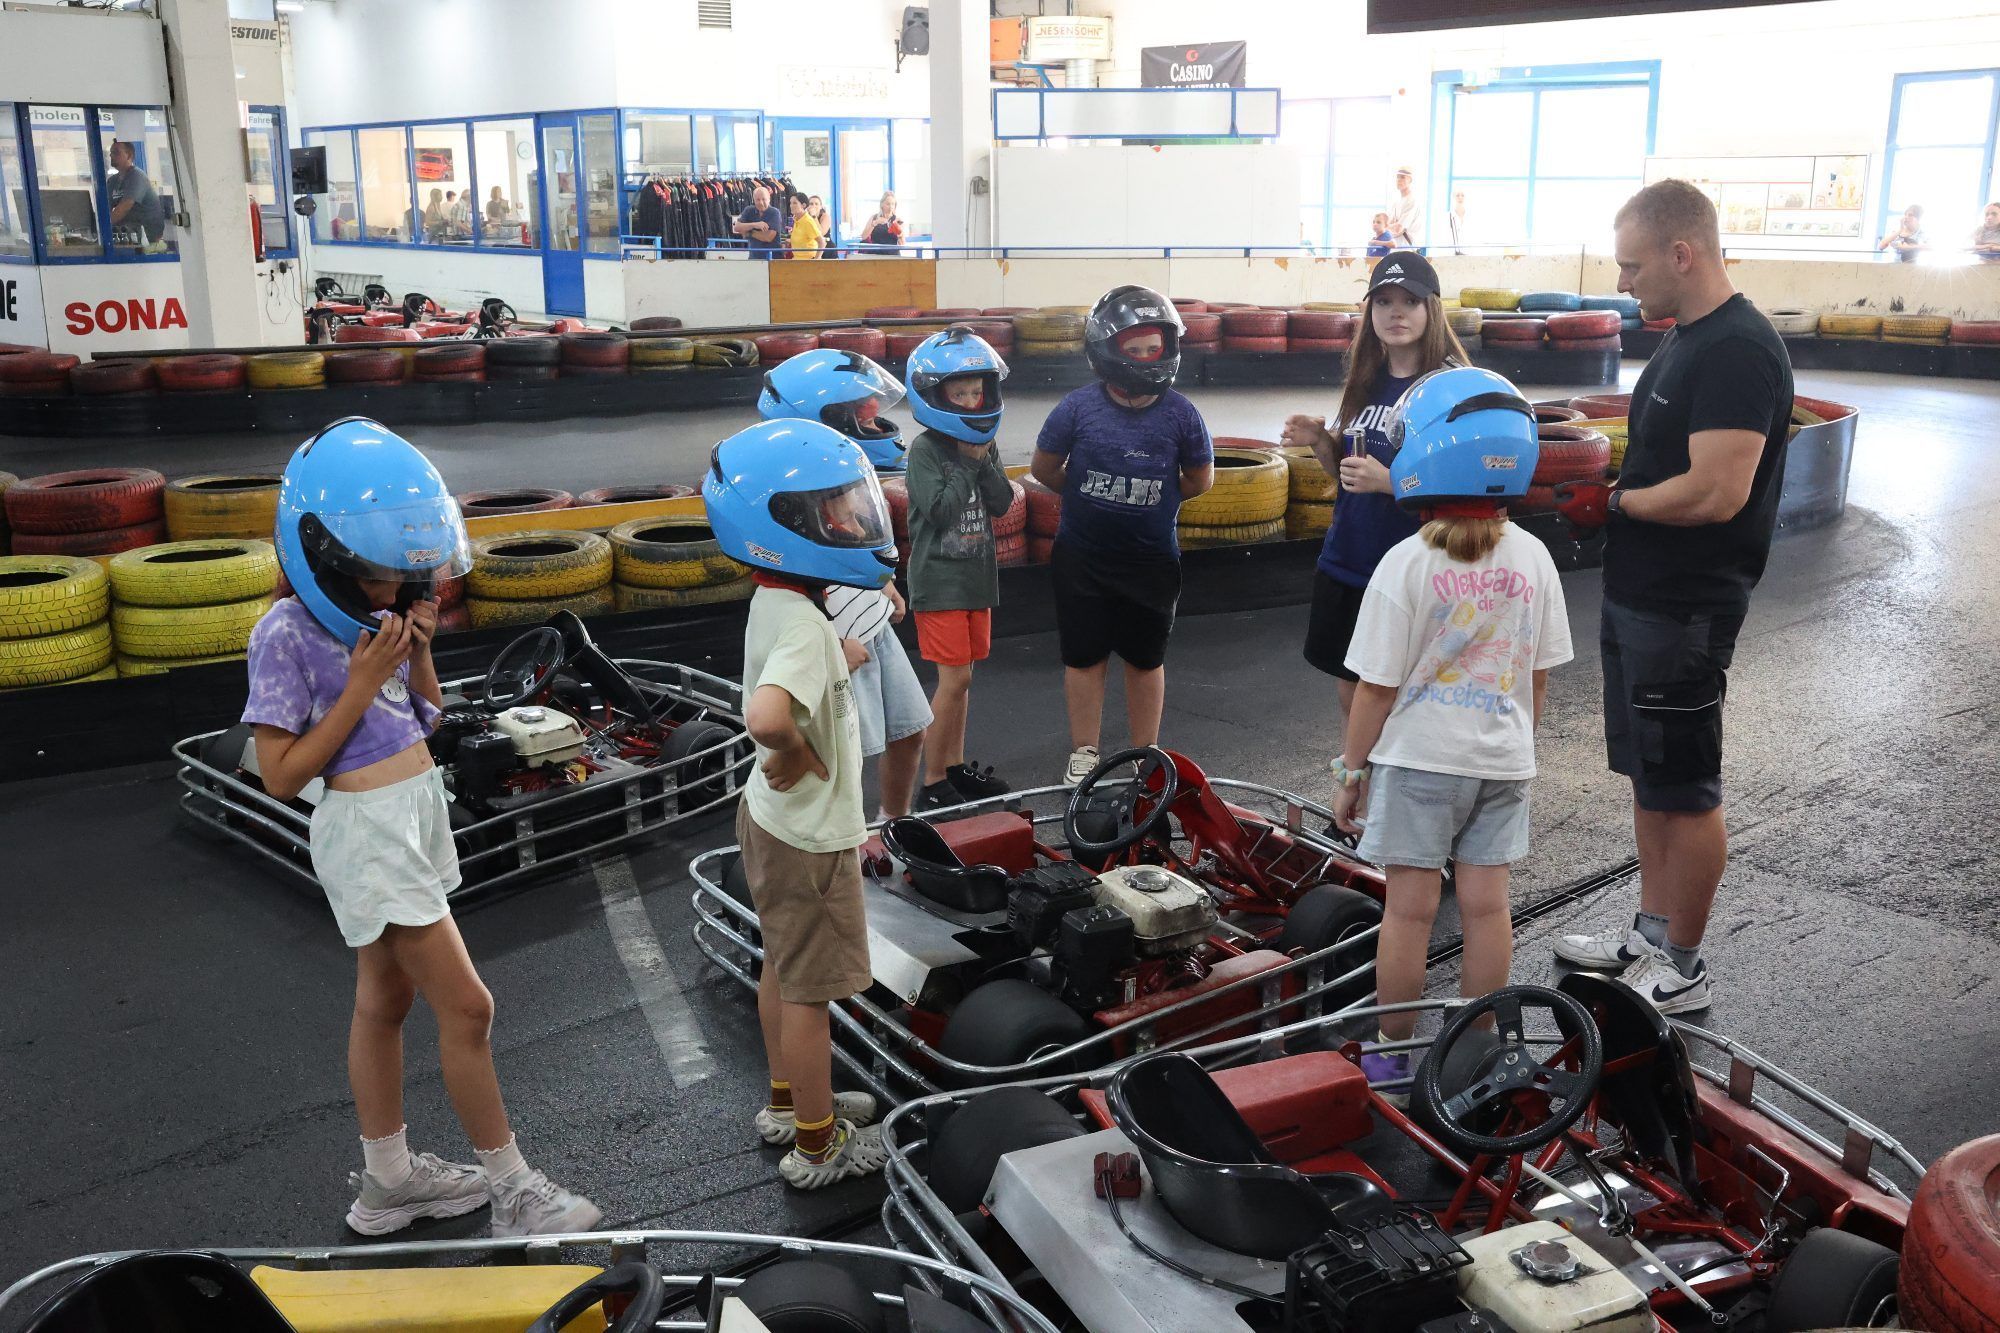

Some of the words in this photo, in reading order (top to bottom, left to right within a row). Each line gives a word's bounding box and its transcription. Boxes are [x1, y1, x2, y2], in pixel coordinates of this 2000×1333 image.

[1170, 63, 1213, 82] CASINO
[64, 297, 188, 336] SONA
[1080, 469, 1163, 506] JEANS
